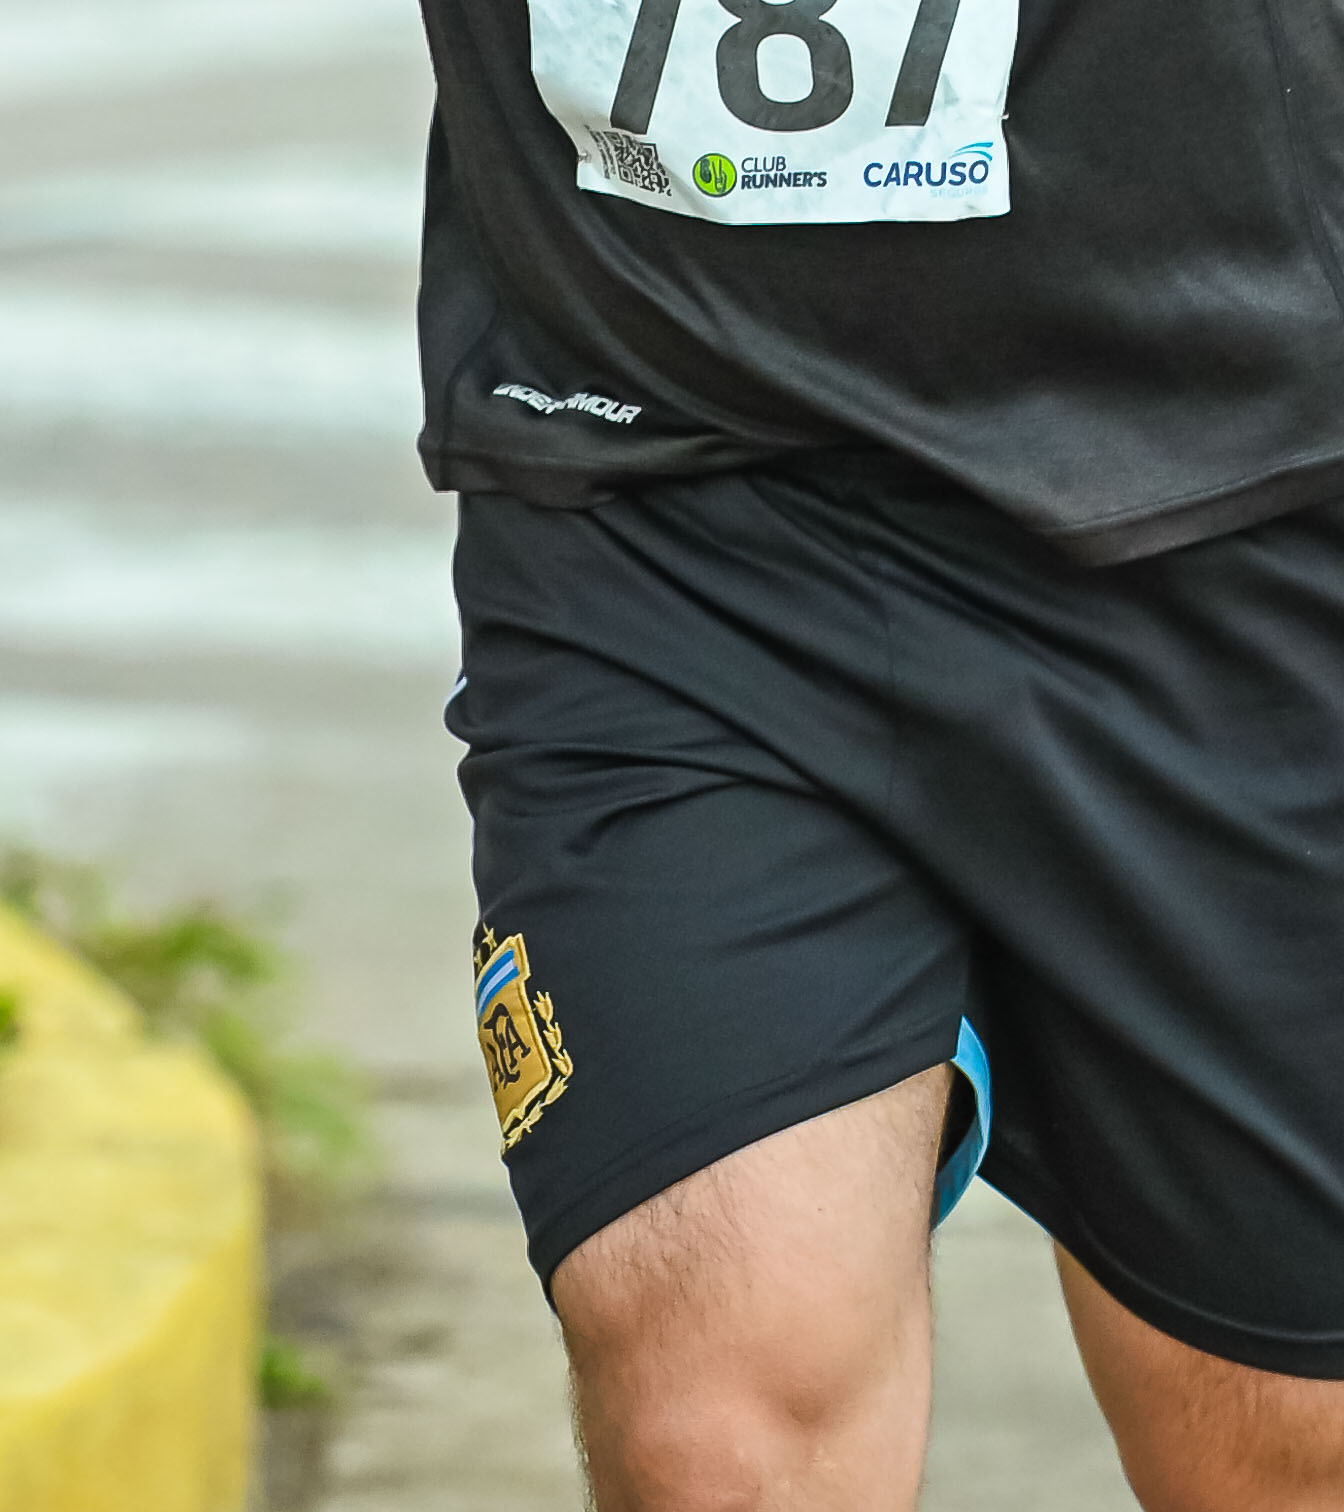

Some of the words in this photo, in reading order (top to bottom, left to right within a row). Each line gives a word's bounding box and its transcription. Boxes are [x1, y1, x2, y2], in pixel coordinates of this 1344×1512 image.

[741, 155, 787, 174] CLUB
[863, 159, 989, 188] CARUSO
[740, 171, 828, 190] RUNNER'S
[555, 392, 642, 424] MOUR
